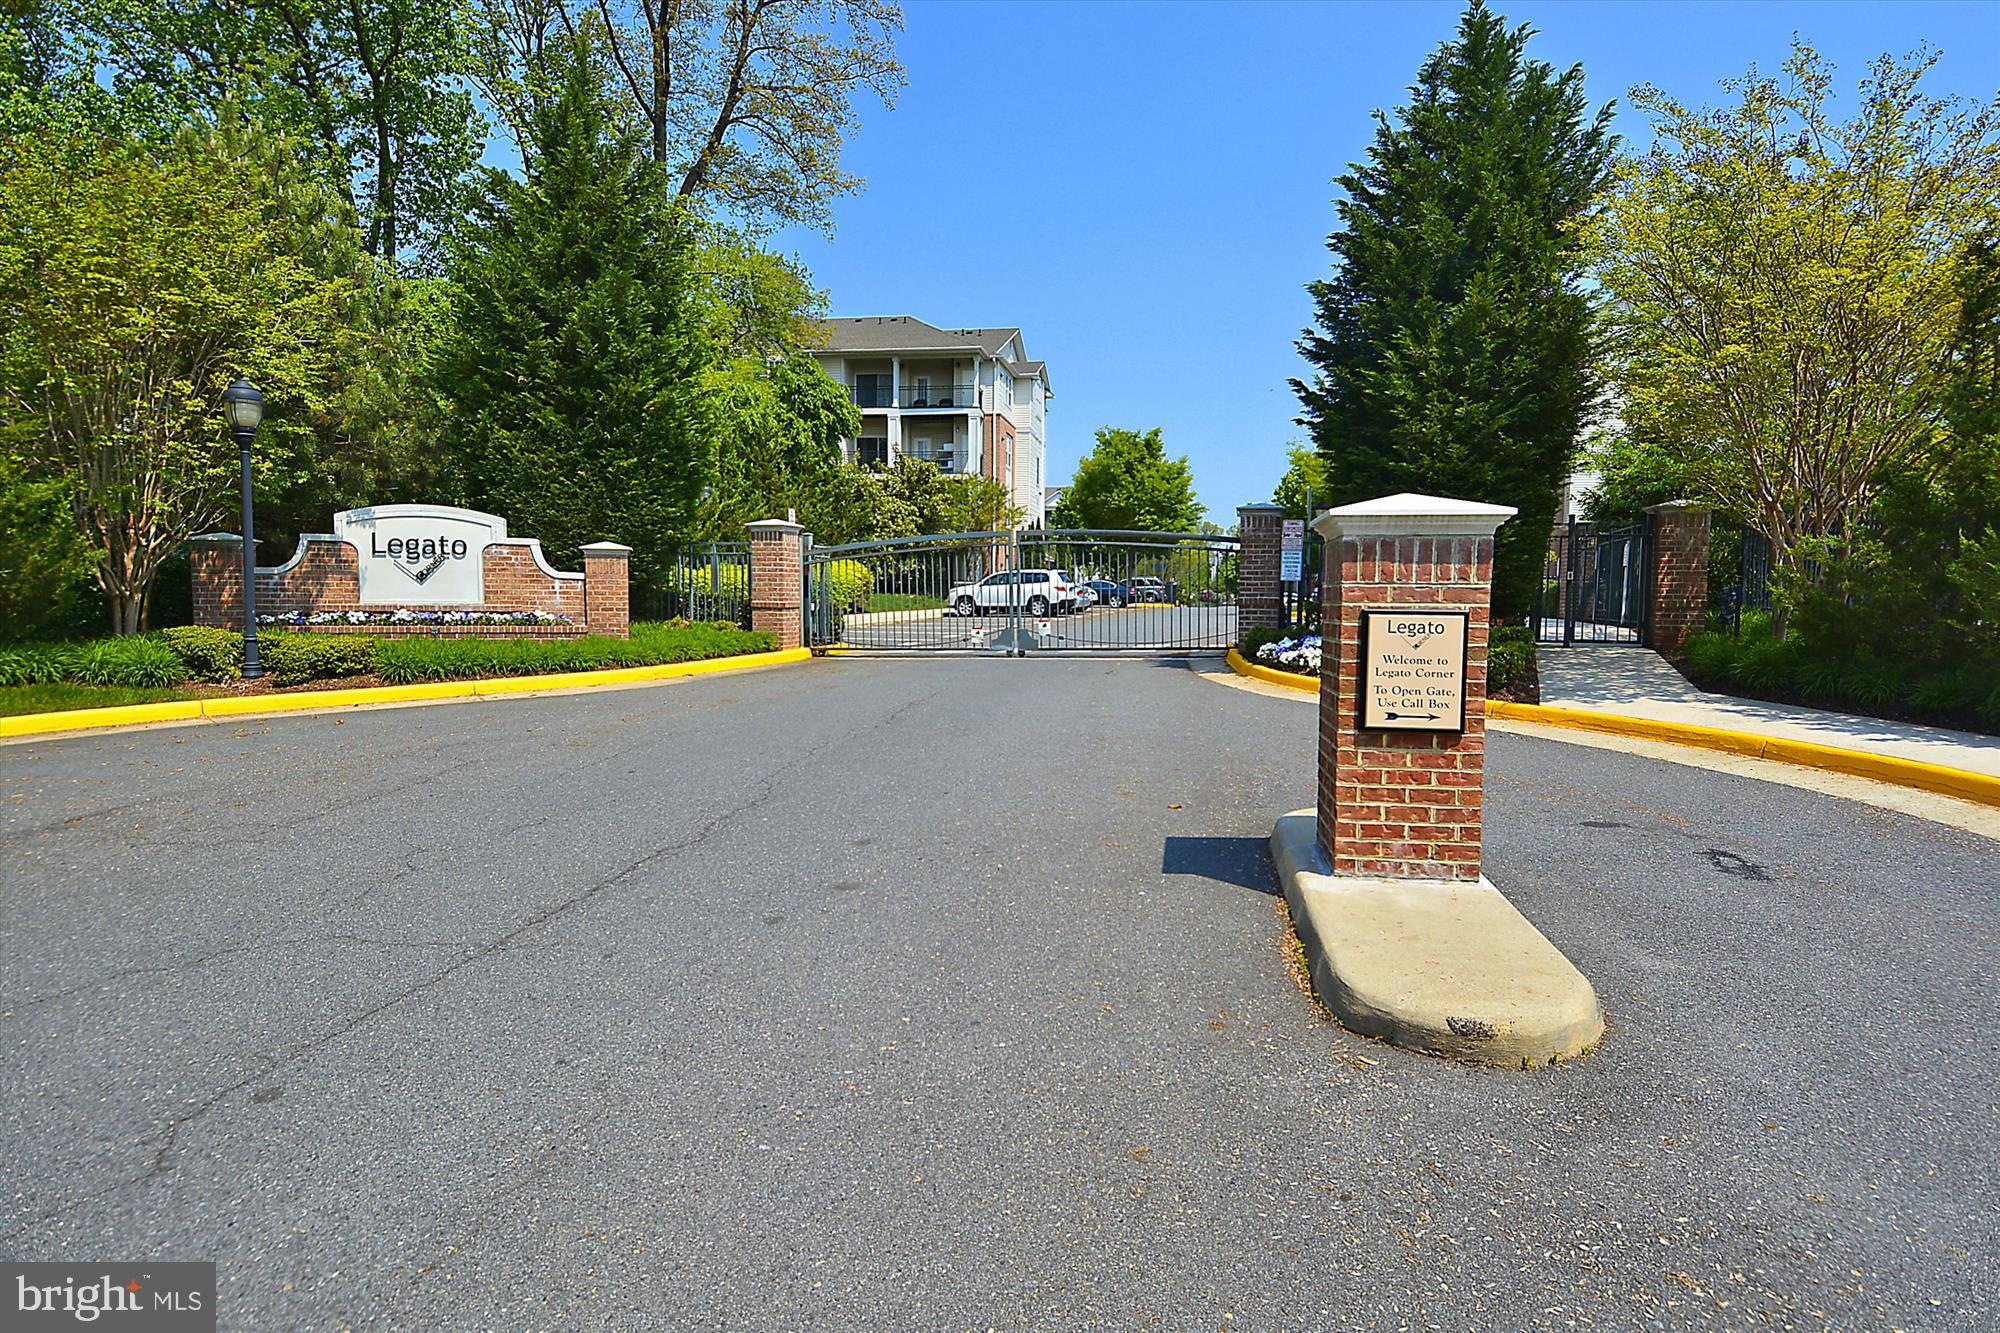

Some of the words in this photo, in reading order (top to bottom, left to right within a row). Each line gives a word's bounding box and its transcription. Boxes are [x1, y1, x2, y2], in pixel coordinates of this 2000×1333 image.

[371, 532, 467, 564] Legato
[1387, 619, 1445, 637] Legato
[1383, 655, 1433, 665] Welcome
[1375, 667, 1411, 679] Legato
[1415, 669, 1455, 678] Corner
[1374, 685, 1388, 695] To
[1391, 686, 1421, 697] Open
[1426, 687, 1455, 697] Gate,
[1378, 698, 1397, 707] Use
[1401, 699, 1423, 708] Call
[1429, 699, 1450, 709] Box
